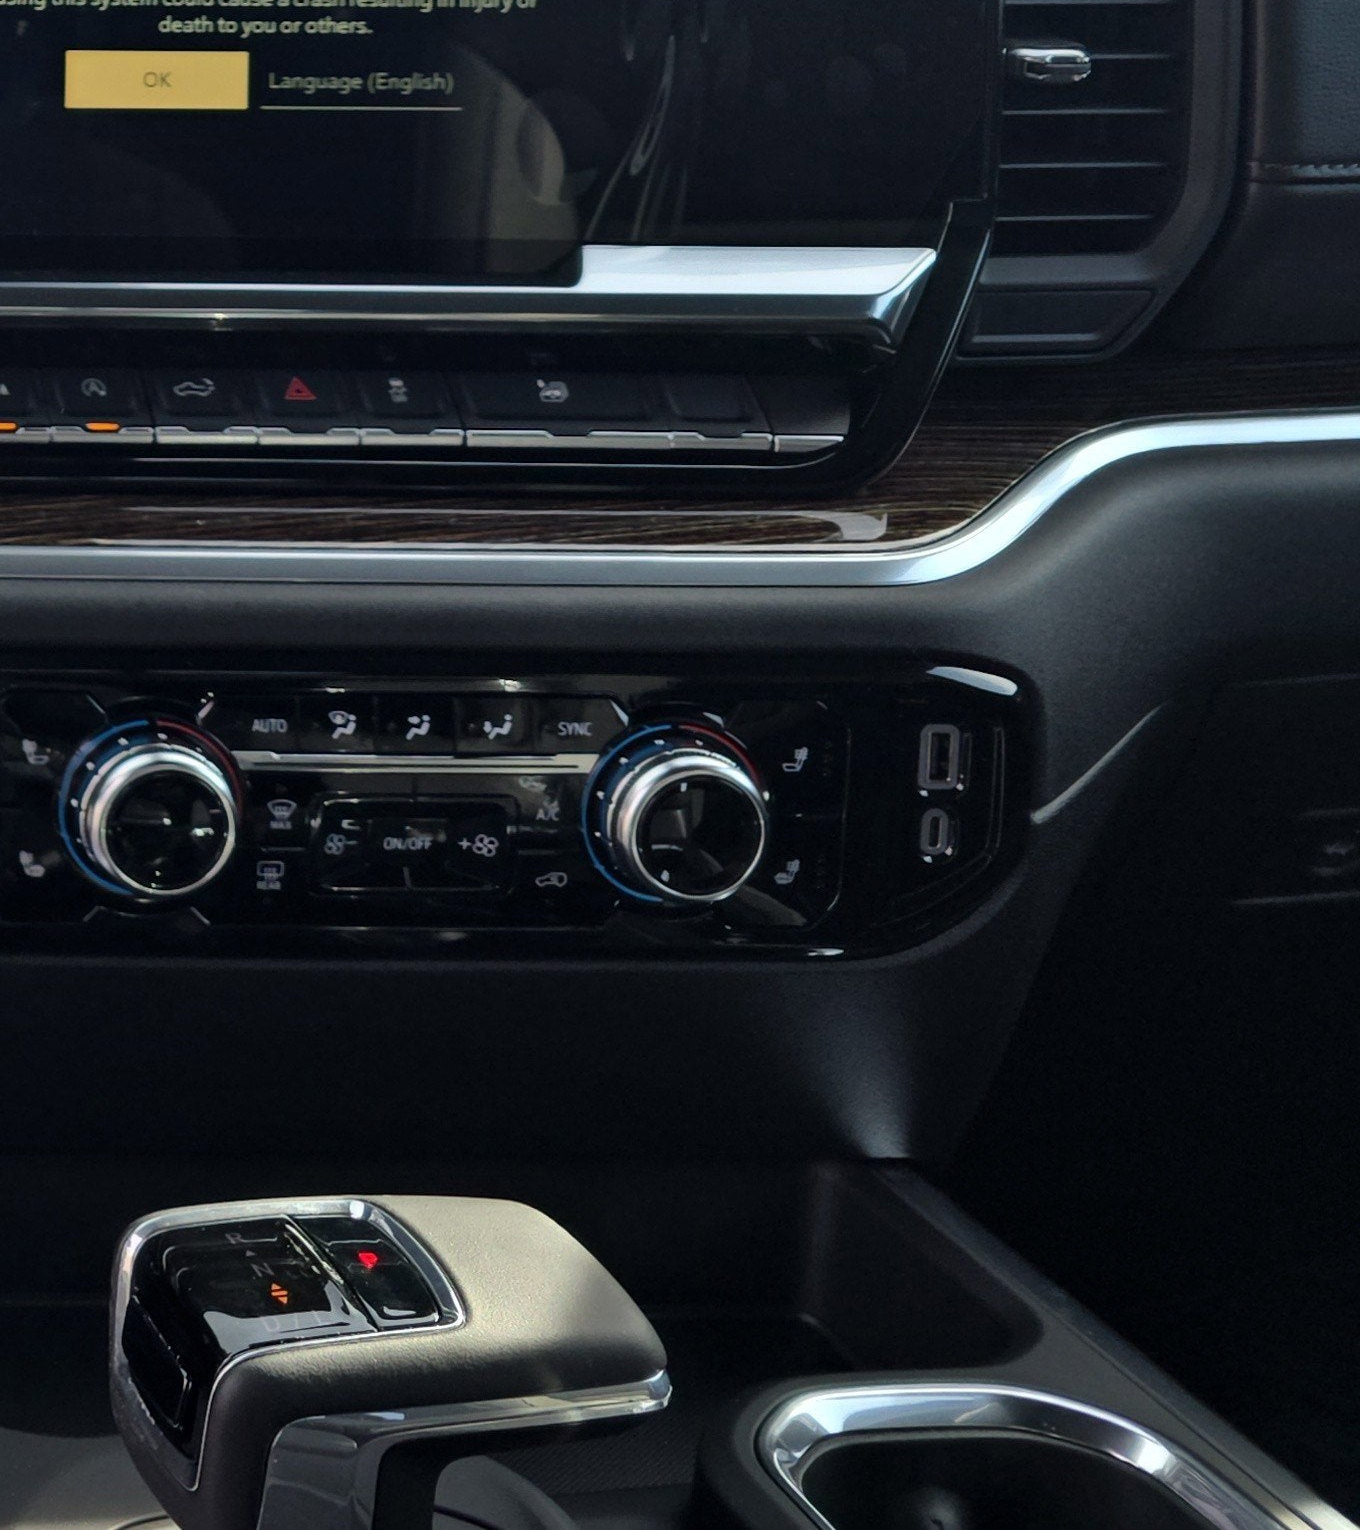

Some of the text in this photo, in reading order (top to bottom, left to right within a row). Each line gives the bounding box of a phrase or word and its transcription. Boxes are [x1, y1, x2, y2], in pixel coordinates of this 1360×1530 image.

[158, 15, 374, 38] death to you or others.
[142, 71, 173, 88] OK
[268, 72, 454, 95] Language (English)
[252, 718, 288, 734] AUTO
[557, 721, 594, 737] SYNC
[383, 836, 433, 850] ON/OFF
